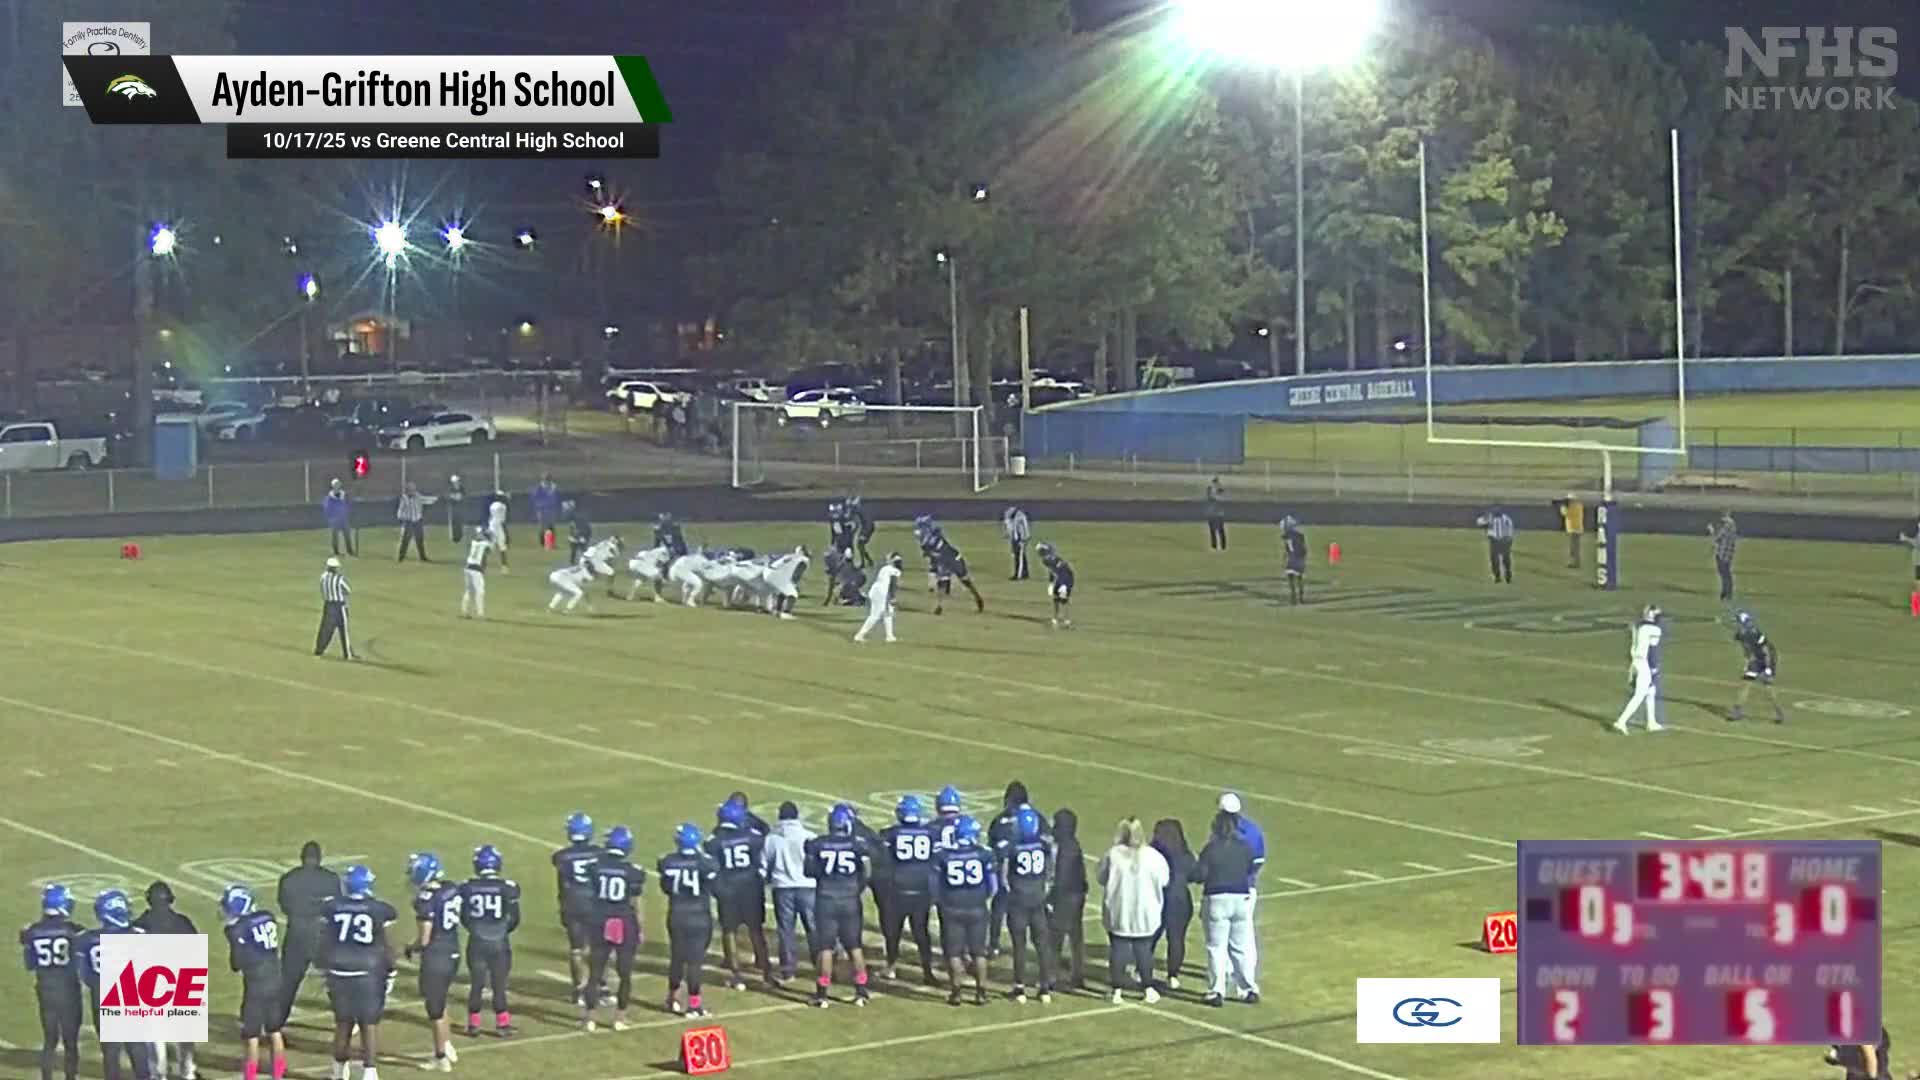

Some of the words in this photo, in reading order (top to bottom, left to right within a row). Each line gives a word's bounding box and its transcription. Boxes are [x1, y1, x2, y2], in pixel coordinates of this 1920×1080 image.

[1597, 506, 1608, 585] RAMS
[723, 844, 750, 869] 15
[896, 835, 931, 860] 58
[819, 850, 856, 875] 75
[947, 859, 983, 886] 53
[599, 876, 625, 901] 10
[665, 868, 700, 896] 74
[469, 895, 502, 919] 34
[251, 920, 279, 950] 42
[333, 913, 374, 944] 73
[1490, 919, 1517, 948] 20
[33, 938, 71, 966] 59
[688, 1033, 722, 1069] 30
